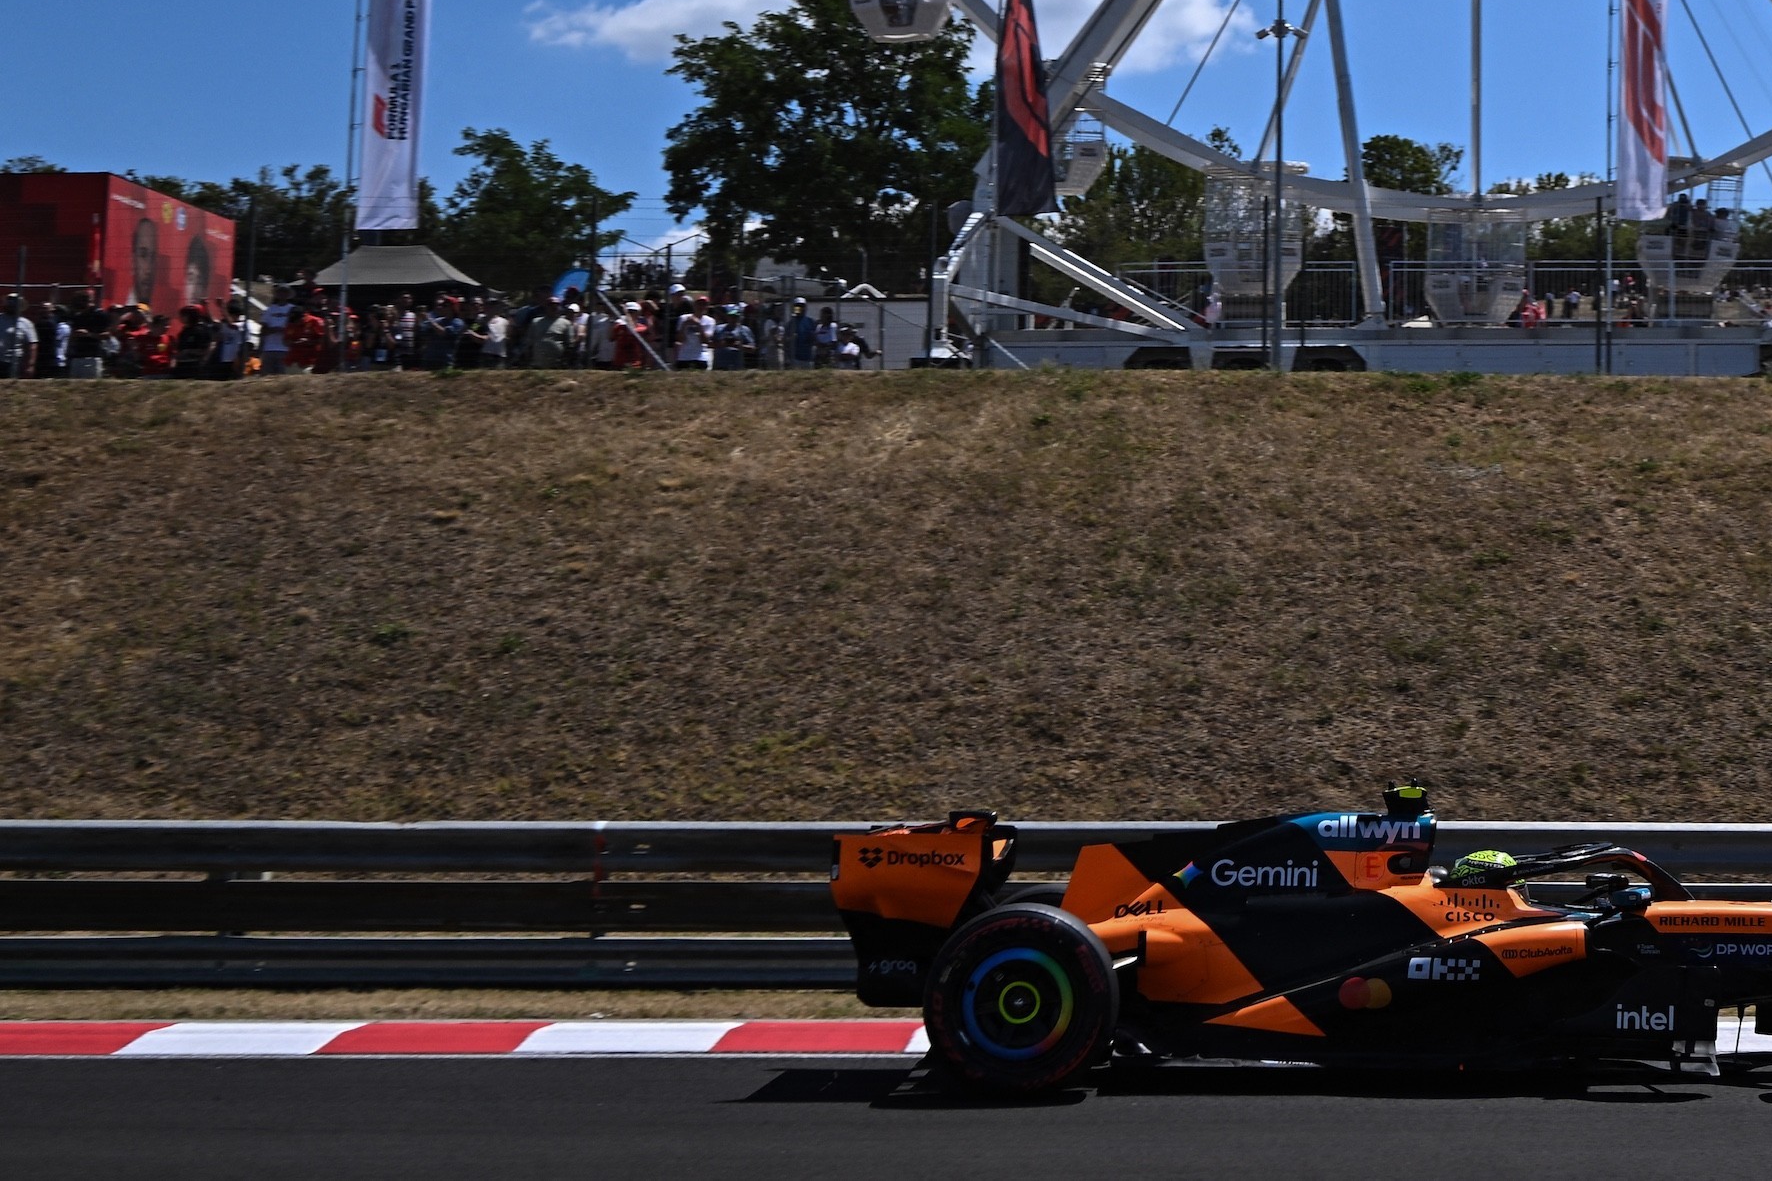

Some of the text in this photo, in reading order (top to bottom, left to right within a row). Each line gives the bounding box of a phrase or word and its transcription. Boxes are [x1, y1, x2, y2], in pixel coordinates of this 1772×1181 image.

[403, 11, 417, 57] GRAND
[387, 73, 400, 140] FORMULA
[398, 59, 413, 141] HUNGARIAN
[1317, 815, 1421, 844] allwyn
[887, 850, 966, 868] Dropbox
[1366, 856, 1379, 878] E
[1210, 858, 1319, 887] Gemini
[1461, 875, 1486, 888] okta
[1114, 900, 1167, 919] DELL
[1445, 912, 1495, 922] CISCO
[1659, 916, 1765, 927] RICHARD MILLE
[1519, 946, 1573, 959] ClubAvolta
[1716, 944, 1739, 955] DP
[880, 959, 918, 974] groq
[1407, 956, 1481, 981] OKX
[1616, 1003, 1675, 1032] intel
